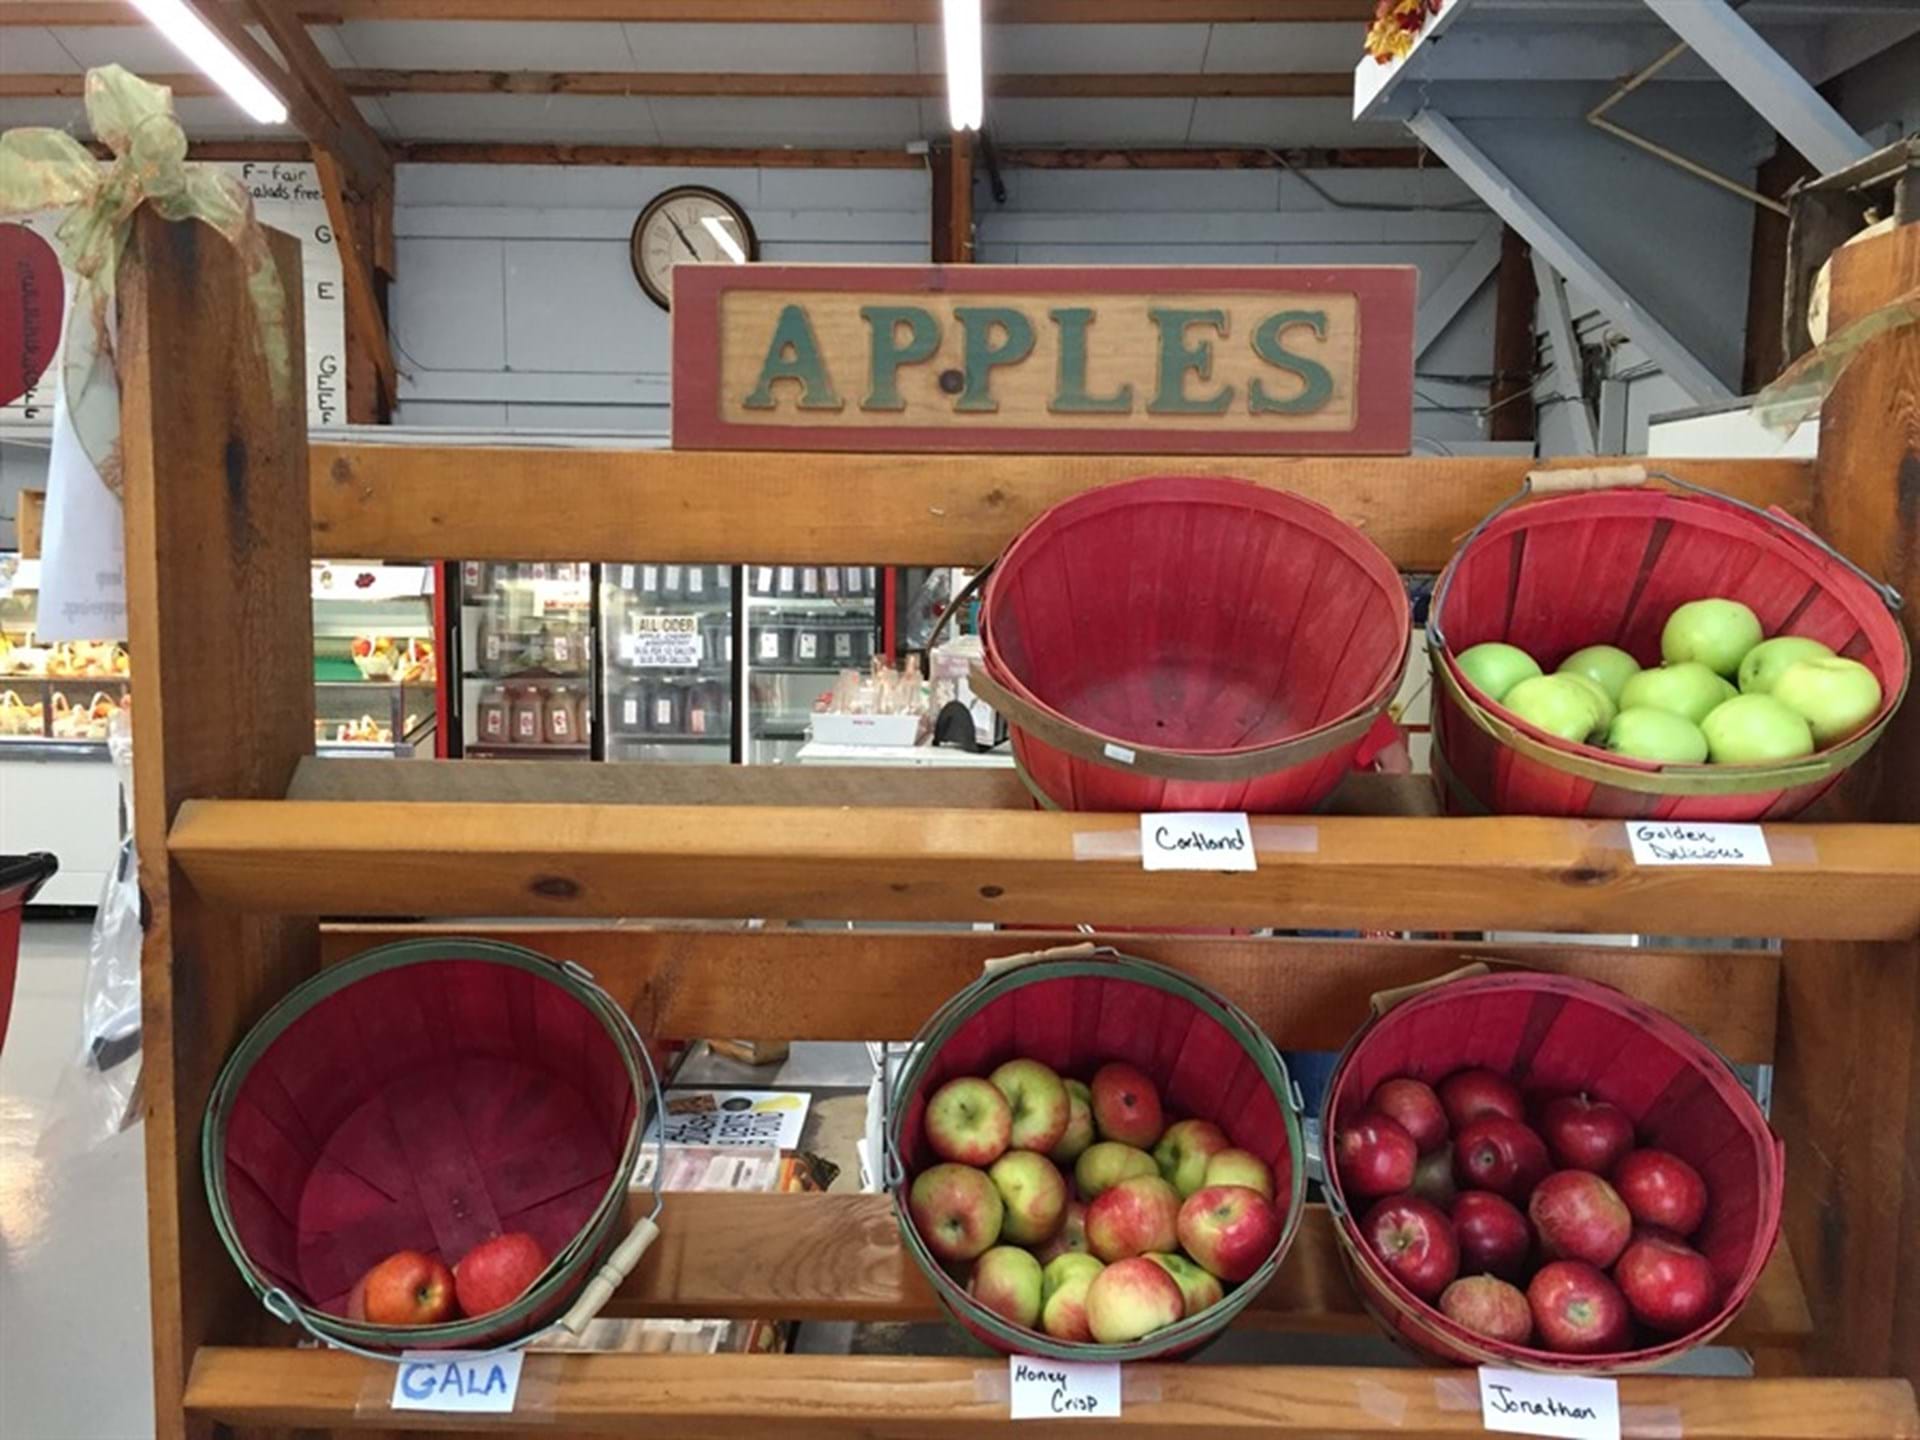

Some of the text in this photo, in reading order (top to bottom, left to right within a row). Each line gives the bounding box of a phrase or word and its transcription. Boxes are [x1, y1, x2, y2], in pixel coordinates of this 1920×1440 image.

[314, 224, 332, 244] G
[317, 281, 335, 300] E
[742, 304, 1334, 415] APPLES
[640, 618, 658, 632] ALL
[1155, 826, 1245, 851] Cortland
[401, 1361, 507, 1401] GALA
[1015, 1365, 1068, 1391] Honey
[1051, 1388, 1098, 1413] Crisp
[1488, 1384, 1597, 1419] Jonathan
